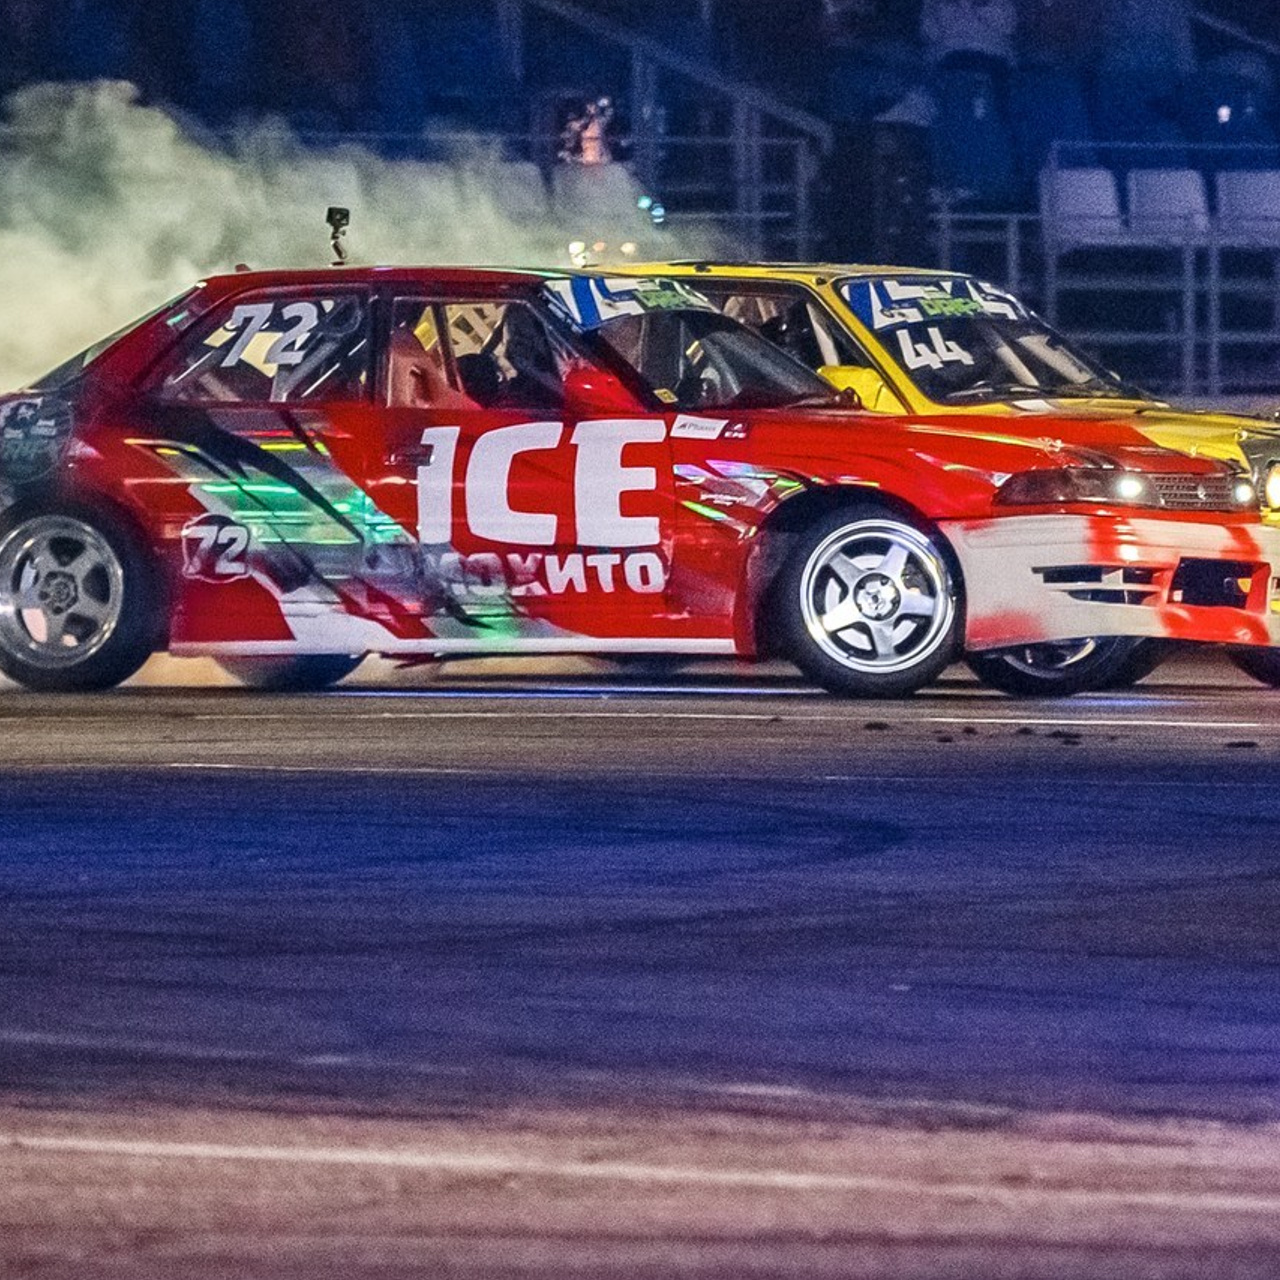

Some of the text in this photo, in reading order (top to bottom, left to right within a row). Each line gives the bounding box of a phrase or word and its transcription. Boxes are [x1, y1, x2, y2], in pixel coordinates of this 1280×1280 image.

[220, 301, 319, 367] 72
[895, 326, 975, 370] 44
[417, 419, 667, 547] ICE
[181, 525, 249, 574] 72
